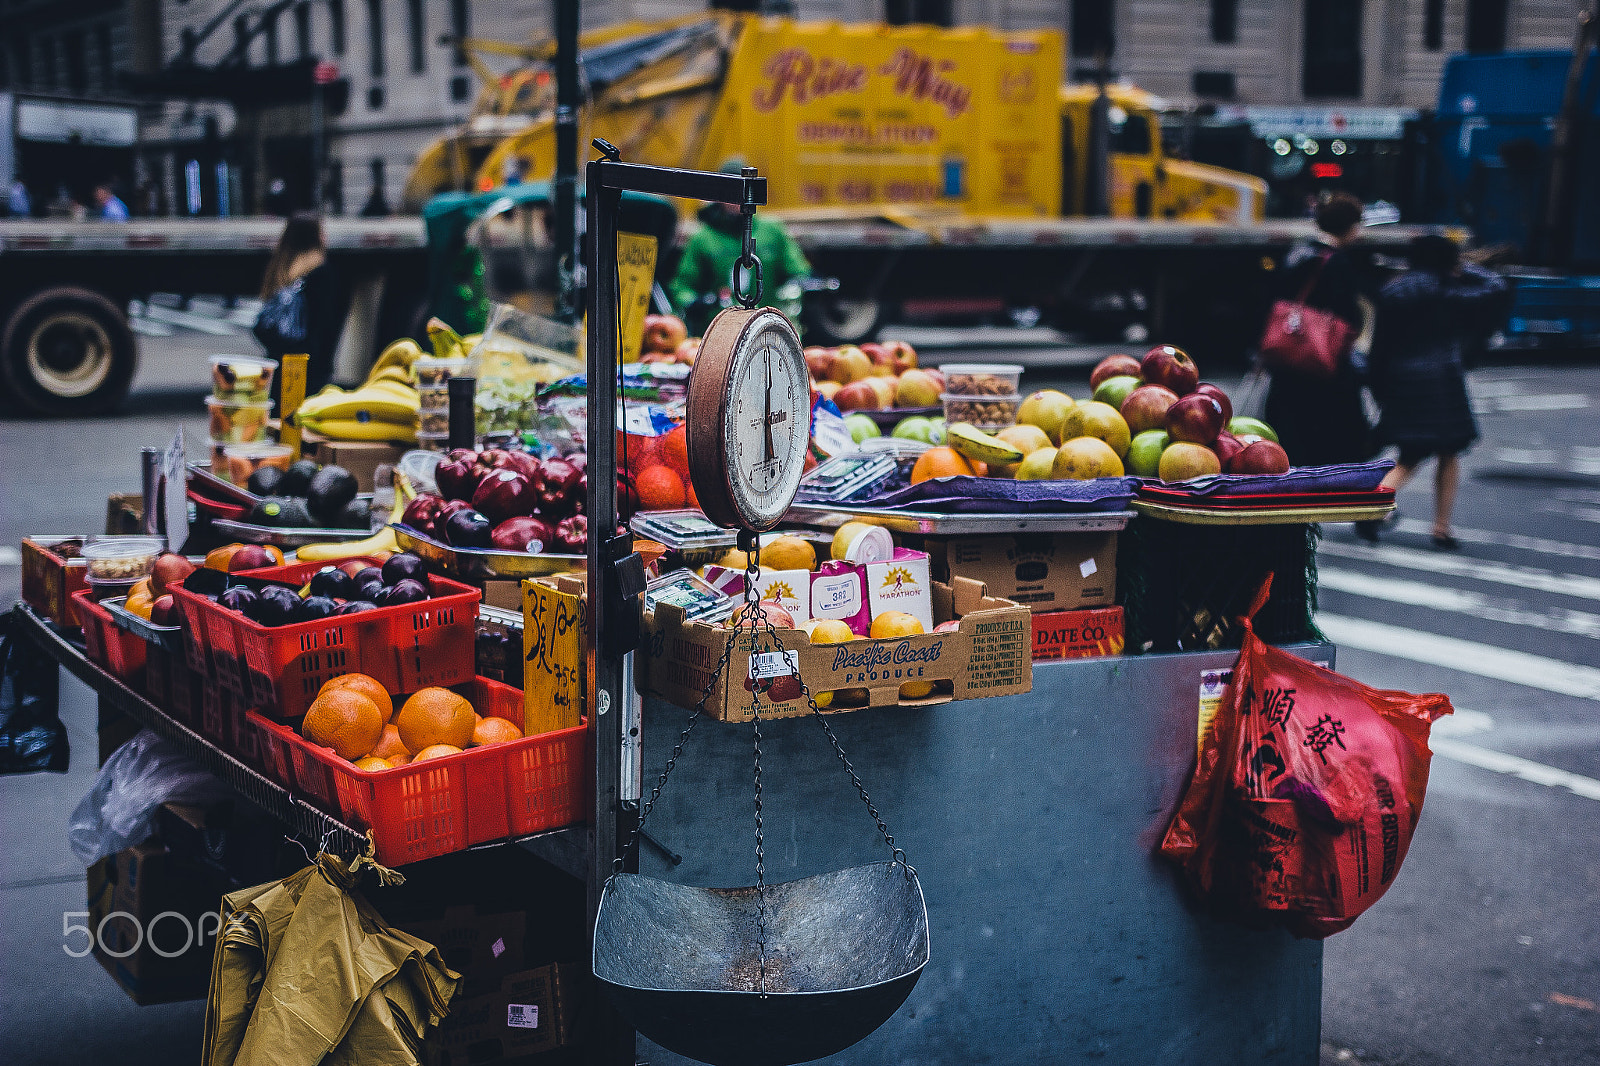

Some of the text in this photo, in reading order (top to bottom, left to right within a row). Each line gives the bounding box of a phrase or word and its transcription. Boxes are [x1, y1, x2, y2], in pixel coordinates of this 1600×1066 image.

[880, 591, 921, 600] MARATHON
[1037, 626, 1107, 645] DATE CO.
[832, 640, 942, 673] Pacific Coast
[846, 667, 924, 683] PRODUCE
